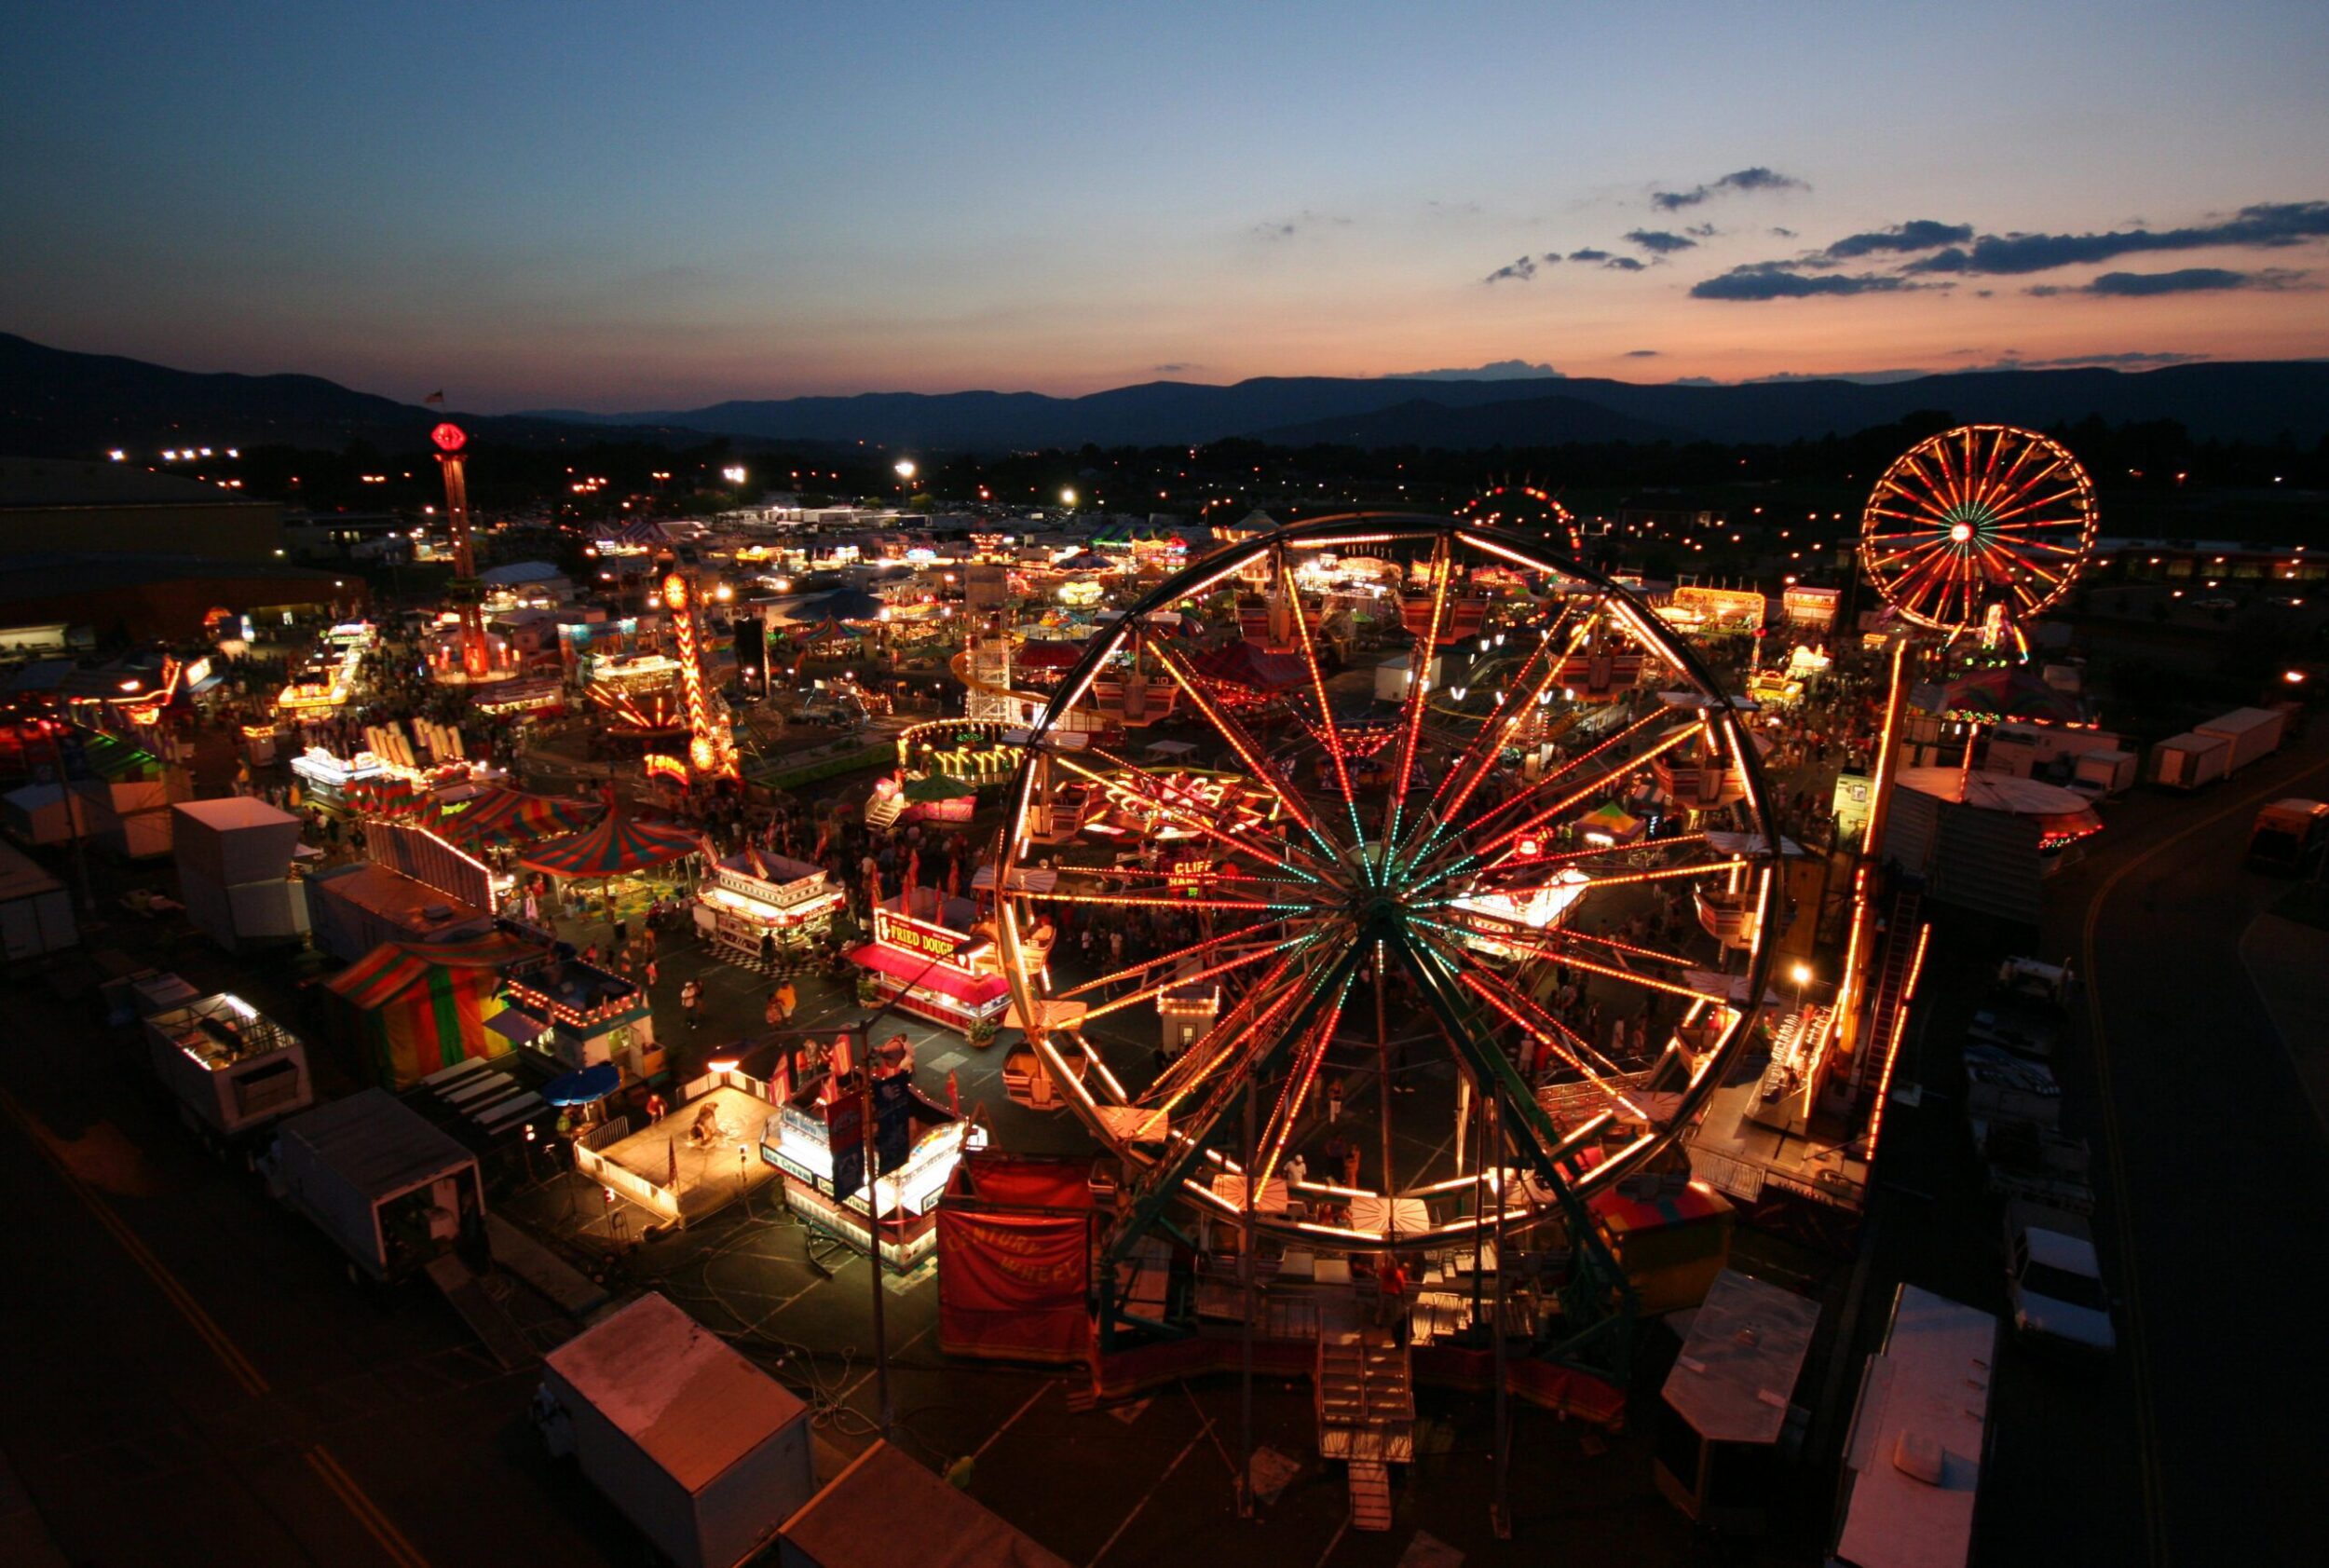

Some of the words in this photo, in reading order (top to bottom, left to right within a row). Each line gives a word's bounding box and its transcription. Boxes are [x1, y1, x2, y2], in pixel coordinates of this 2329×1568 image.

[1174, 860, 1212, 874] CLIFF
[890, 924, 919, 947] FRIED
[922, 935, 954, 959] DOUGH
[781, 1159, 811, 1181] Cream
